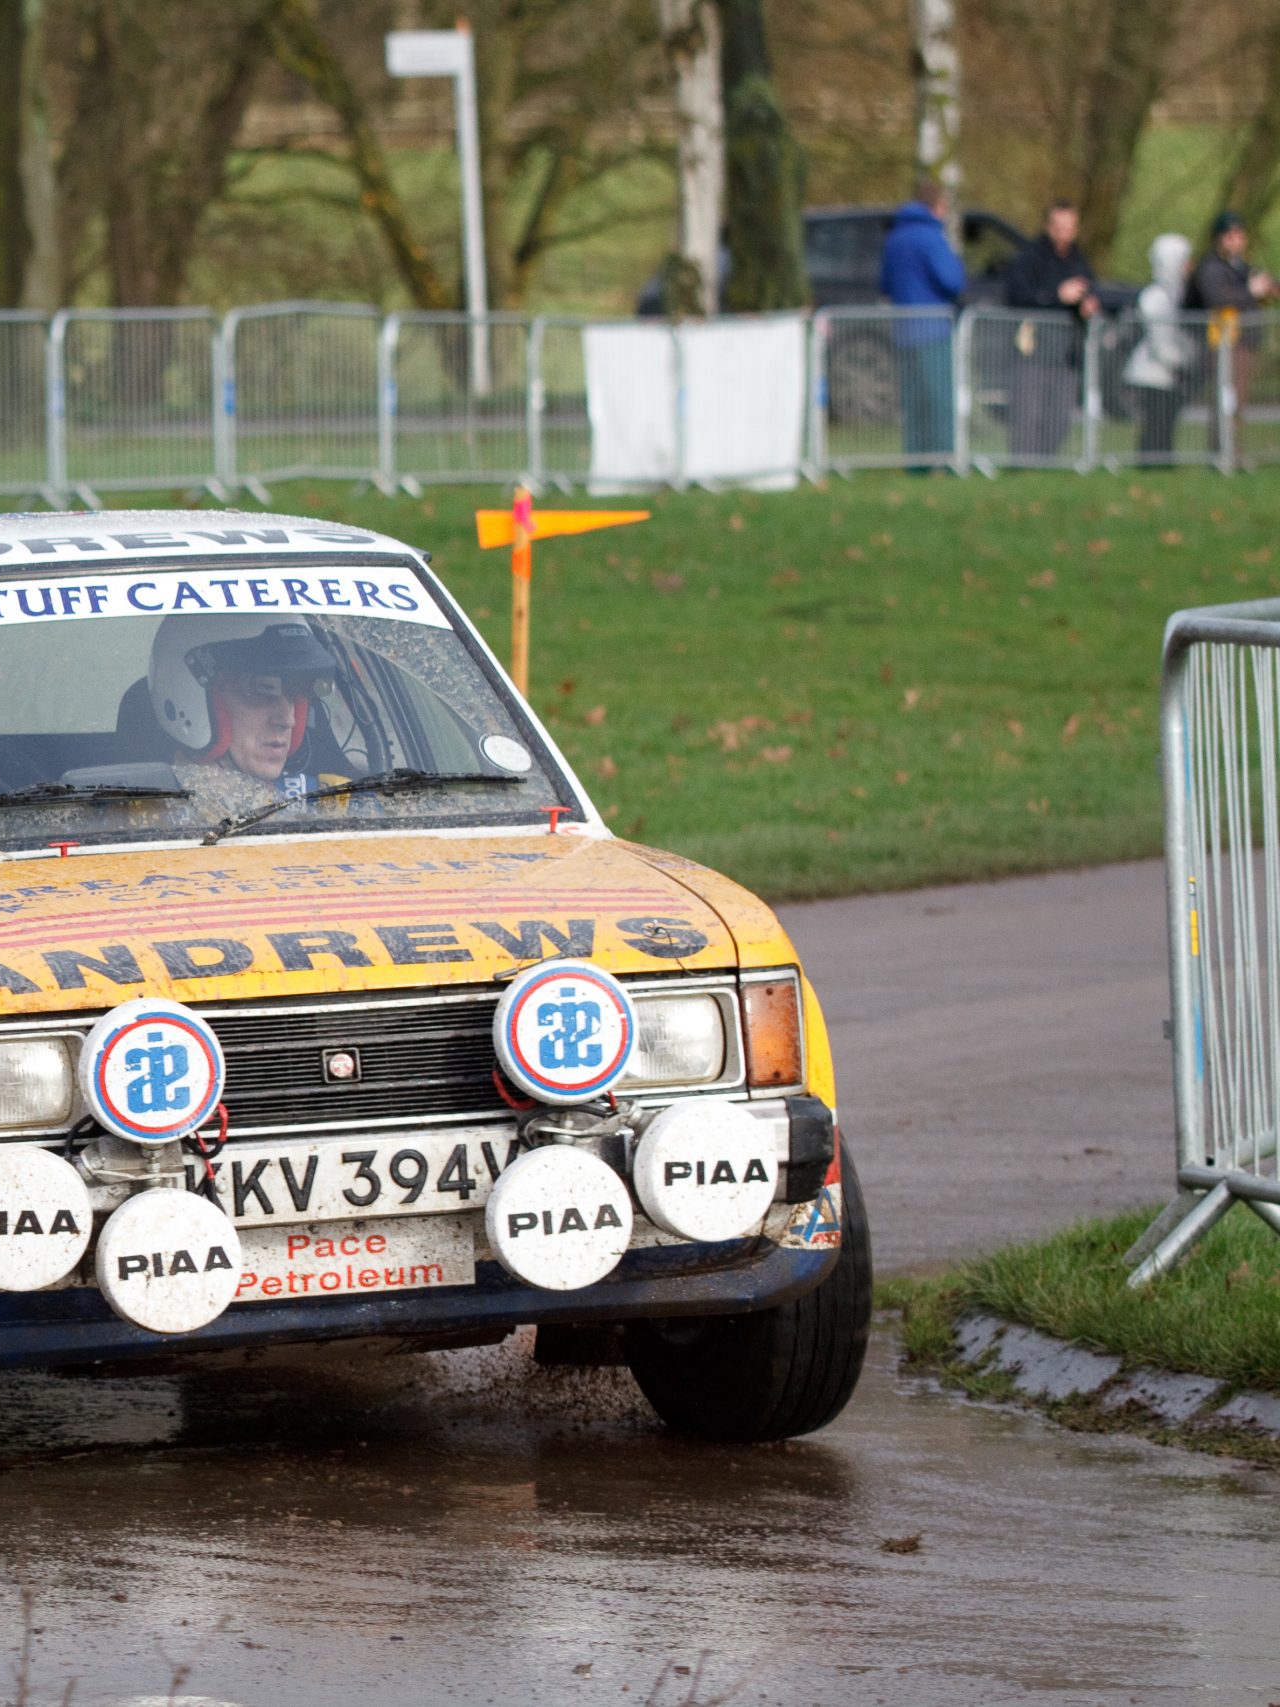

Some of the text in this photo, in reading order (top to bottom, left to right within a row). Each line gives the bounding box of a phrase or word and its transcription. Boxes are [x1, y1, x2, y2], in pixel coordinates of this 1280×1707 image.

[126, 578, 419, 612] CATERERS
[109, 876, 421, 901] CATERERS
[342, 1140, 522, 1207] 394V
[664, 1158, 770, 1187] PIAA
[508, 1203, 623, 1238] PIAA
[118, 1246, 233, 1281] PIAA
[287, 1233, 387, 1260] Pace
[235, 1263, 444, 1297] Petroleum
